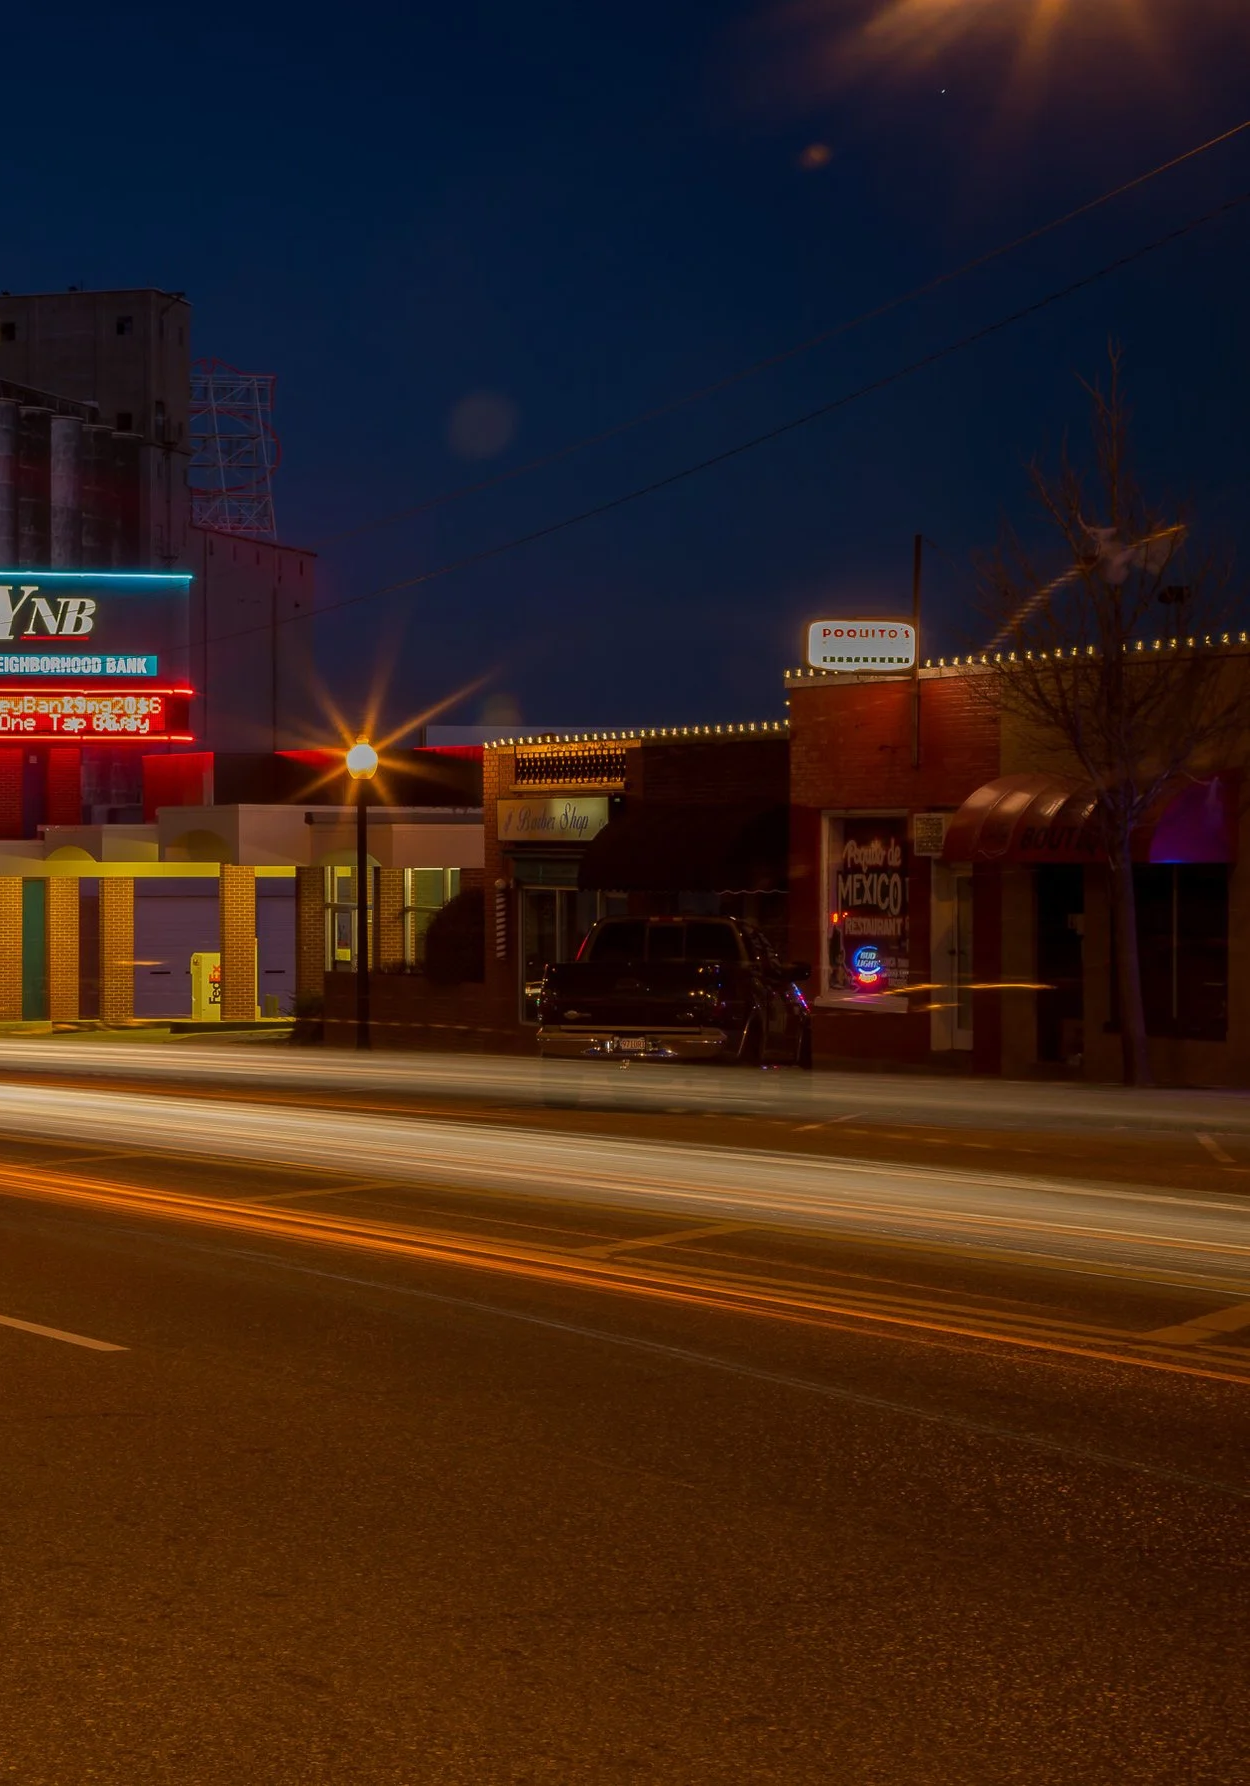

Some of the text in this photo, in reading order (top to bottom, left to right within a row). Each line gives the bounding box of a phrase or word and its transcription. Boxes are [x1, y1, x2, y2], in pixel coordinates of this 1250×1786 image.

[822, 627, 910, 639] POQUITO'S
[106, 657, 148, 675] BANK
[559, 802, 589, 838] Shop
[838, 872, 902, 916] MEXICO
[845, 915, 904, 936] RESTAURANT
[857, 959, 879, 968] LIGHT
[860, 951, 876, 960] BUD
[209, 964, 221, 1005] FedEx
